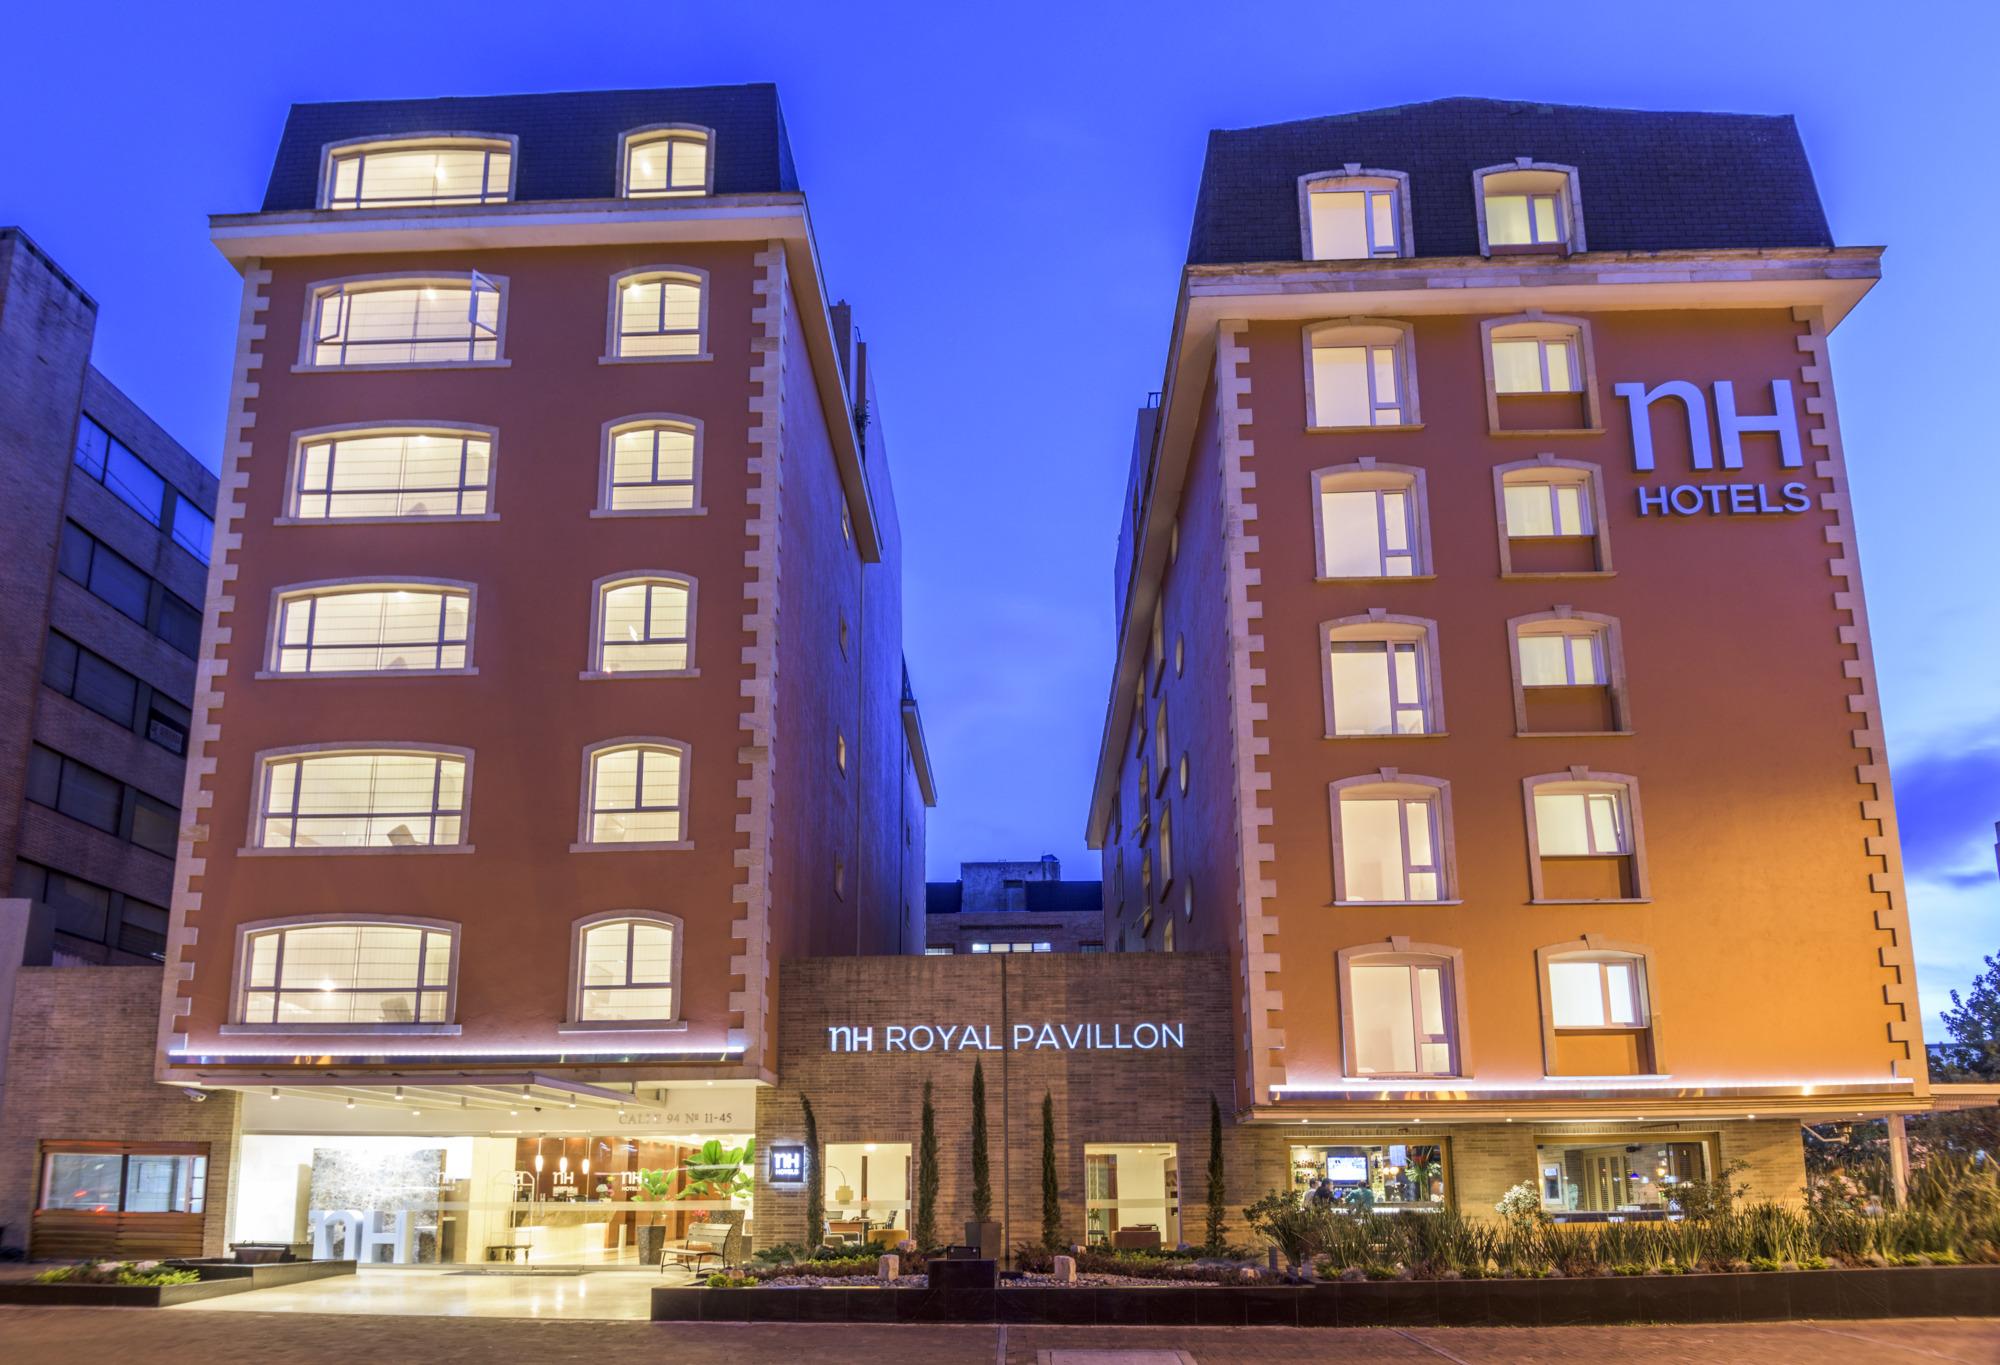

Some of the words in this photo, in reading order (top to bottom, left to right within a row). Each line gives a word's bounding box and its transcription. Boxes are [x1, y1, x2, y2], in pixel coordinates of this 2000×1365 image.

[1637, 482, 1812, 518] HOTELS
[886, 1024, 1003, 1051] ROYAL
[1013, 1022, 1184, 1050] PAVILLON
[666, 1113, 680, 1124] 94
[704, 1112, 732, 1124] 11-45
[775, 1168, 799, 1176] HOTELS
